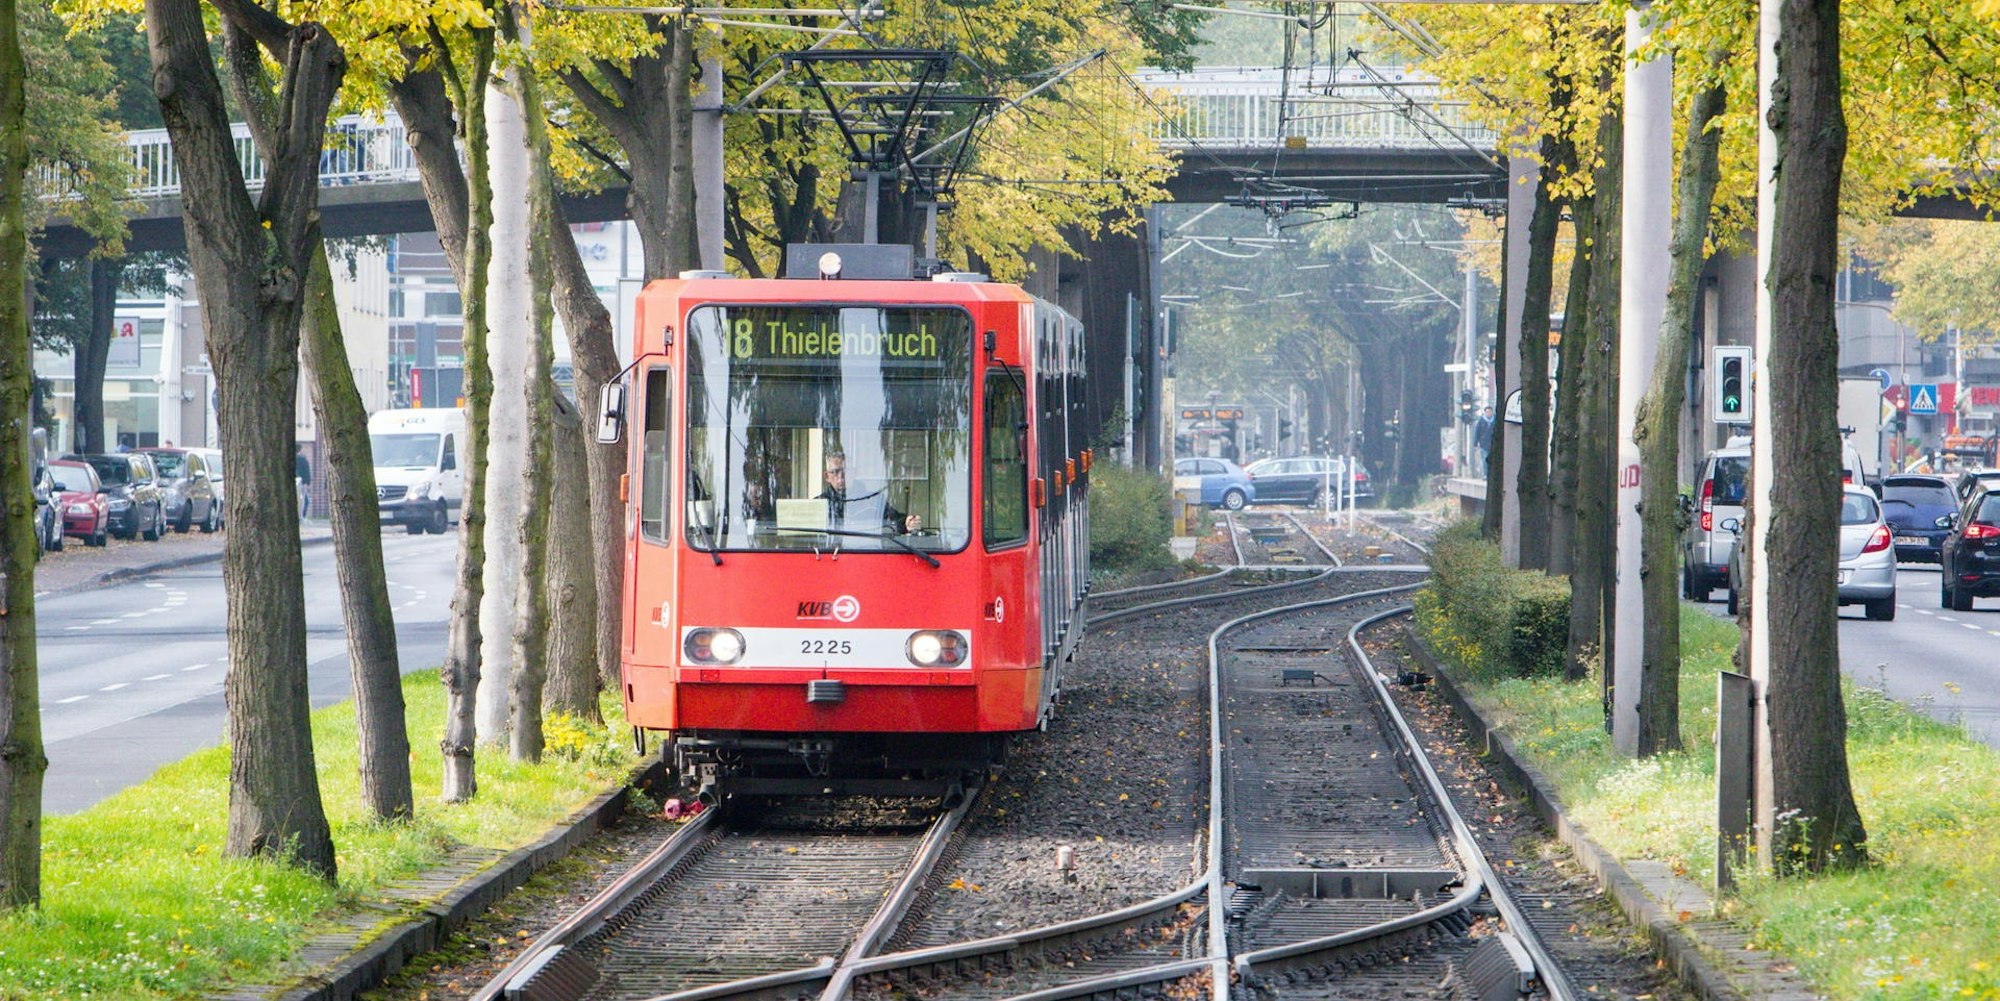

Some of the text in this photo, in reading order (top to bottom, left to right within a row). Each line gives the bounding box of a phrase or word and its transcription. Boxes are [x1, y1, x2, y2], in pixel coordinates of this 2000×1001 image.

[766, 321, 937, 356] Thielenbruch
[797, 601, 833, 617] KVB
[801, 640, 851, 655] 2225
